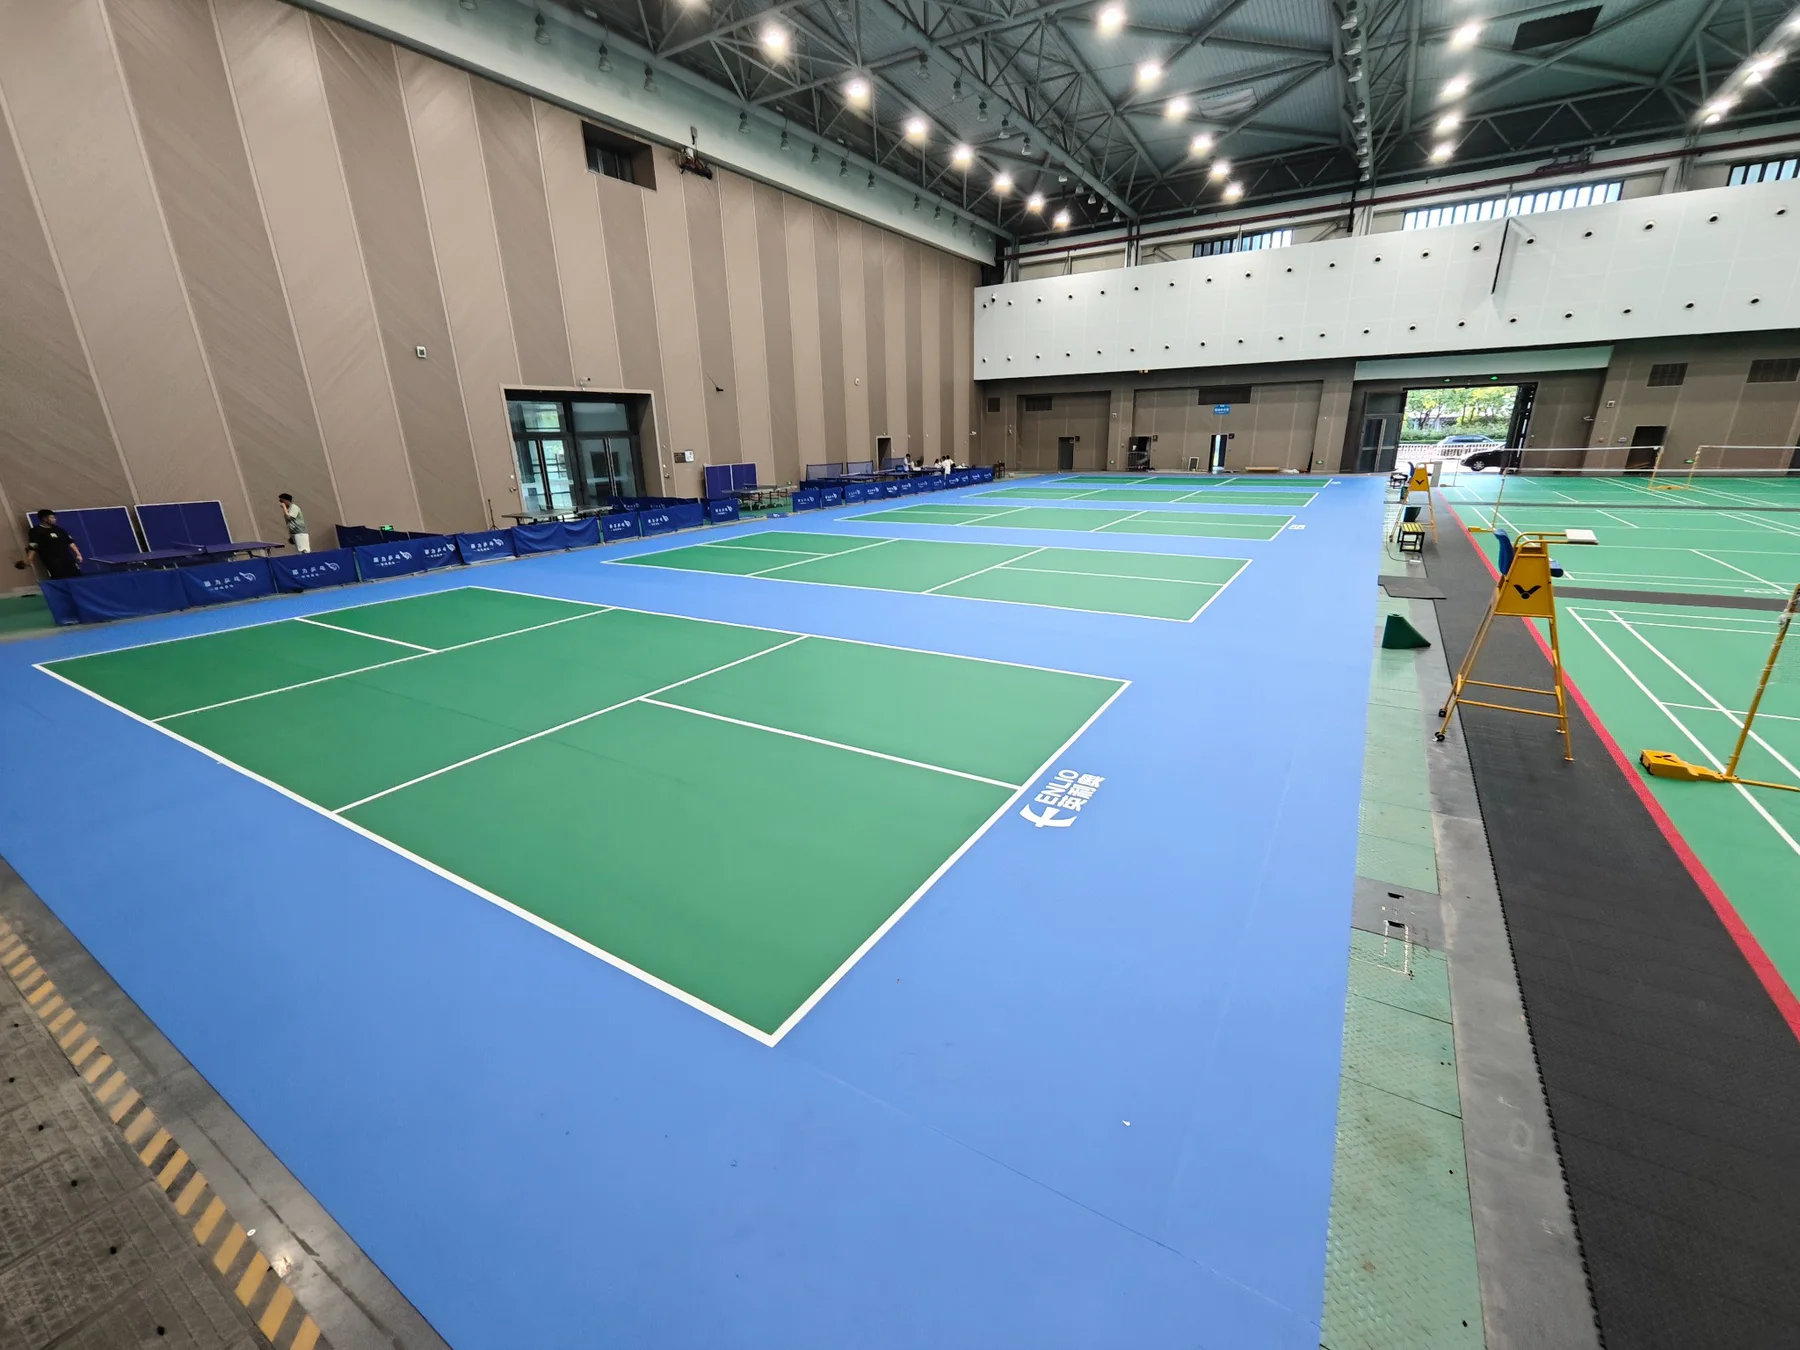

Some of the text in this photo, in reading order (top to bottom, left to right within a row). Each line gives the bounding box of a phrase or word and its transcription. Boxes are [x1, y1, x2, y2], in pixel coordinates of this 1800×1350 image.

[1034, 769, 1079, 806] ENLIO
[1057, 773, 1106, 812] 英利奥
